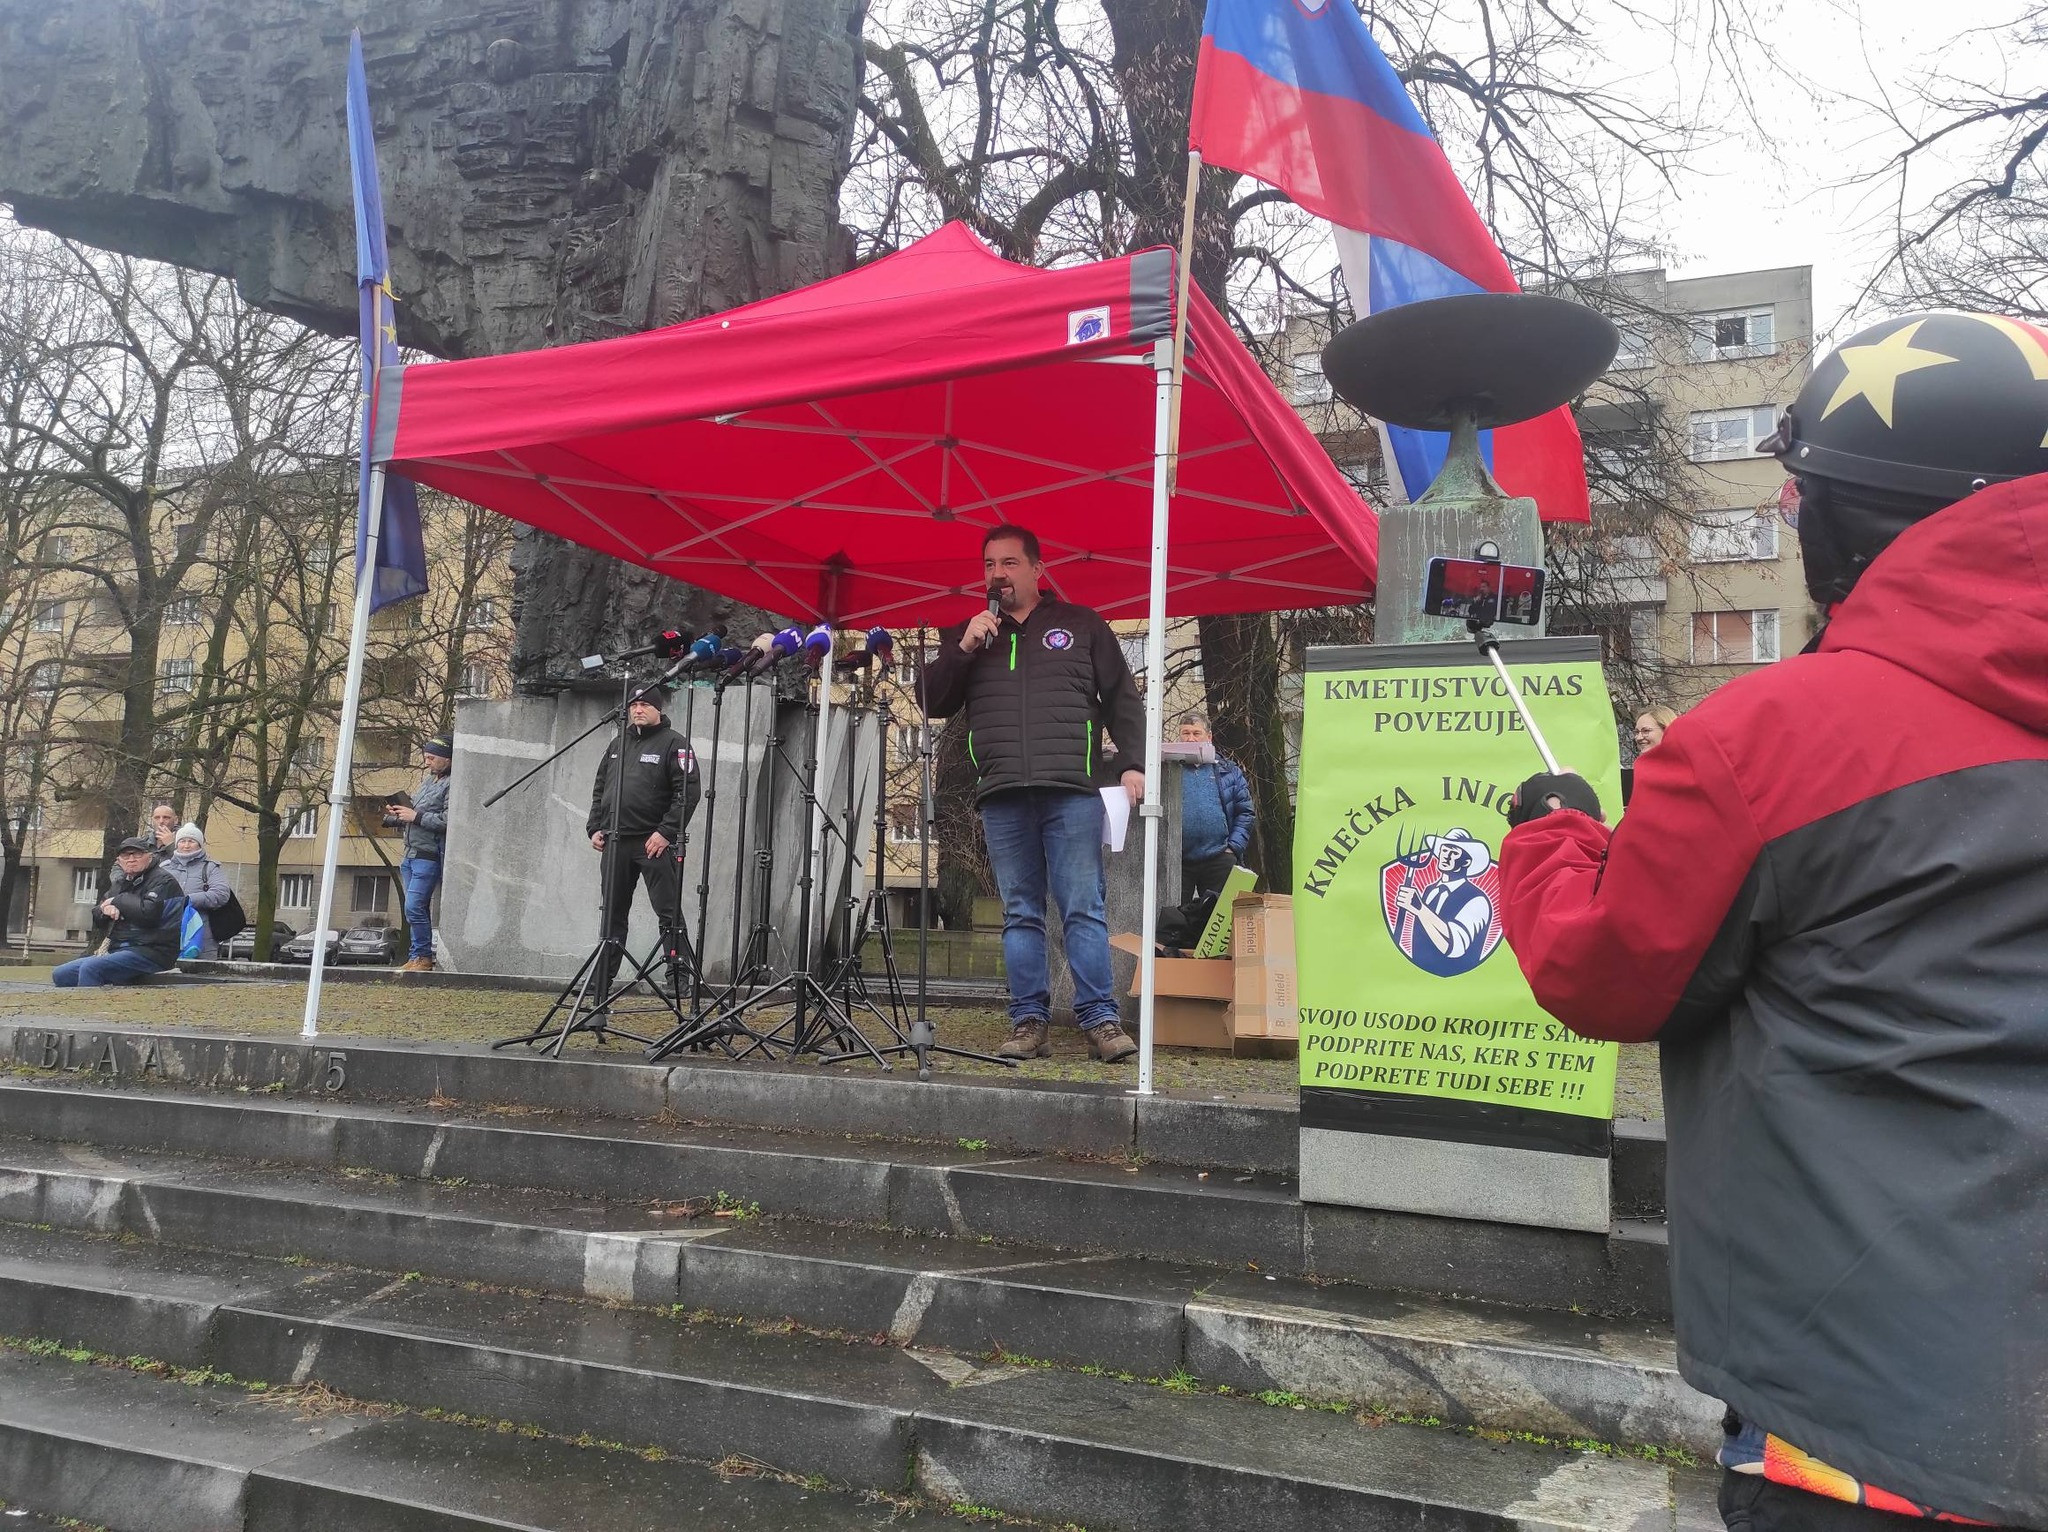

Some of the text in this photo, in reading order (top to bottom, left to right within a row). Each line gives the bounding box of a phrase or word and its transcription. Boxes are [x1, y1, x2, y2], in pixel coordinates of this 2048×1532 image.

[1324, 674, 1584, 703] KMETIJSTVO NAS
[1373, 710, 1526, 736] POVEZUJE
[1303, 785, 1417, 899] KMEČKA
[1298, 1007, 1358, 1029] SVOJO
[1362, 1011, 1437, 1034] USODO
[1442, 1017, 1539, 1042] KROJITE
[1305, 1034, 1596, 1073] PODPRITE NAS, KER S TEM
[1314, 1061, 1586, 1101] PODPRETE TUDI SEBE !!!
